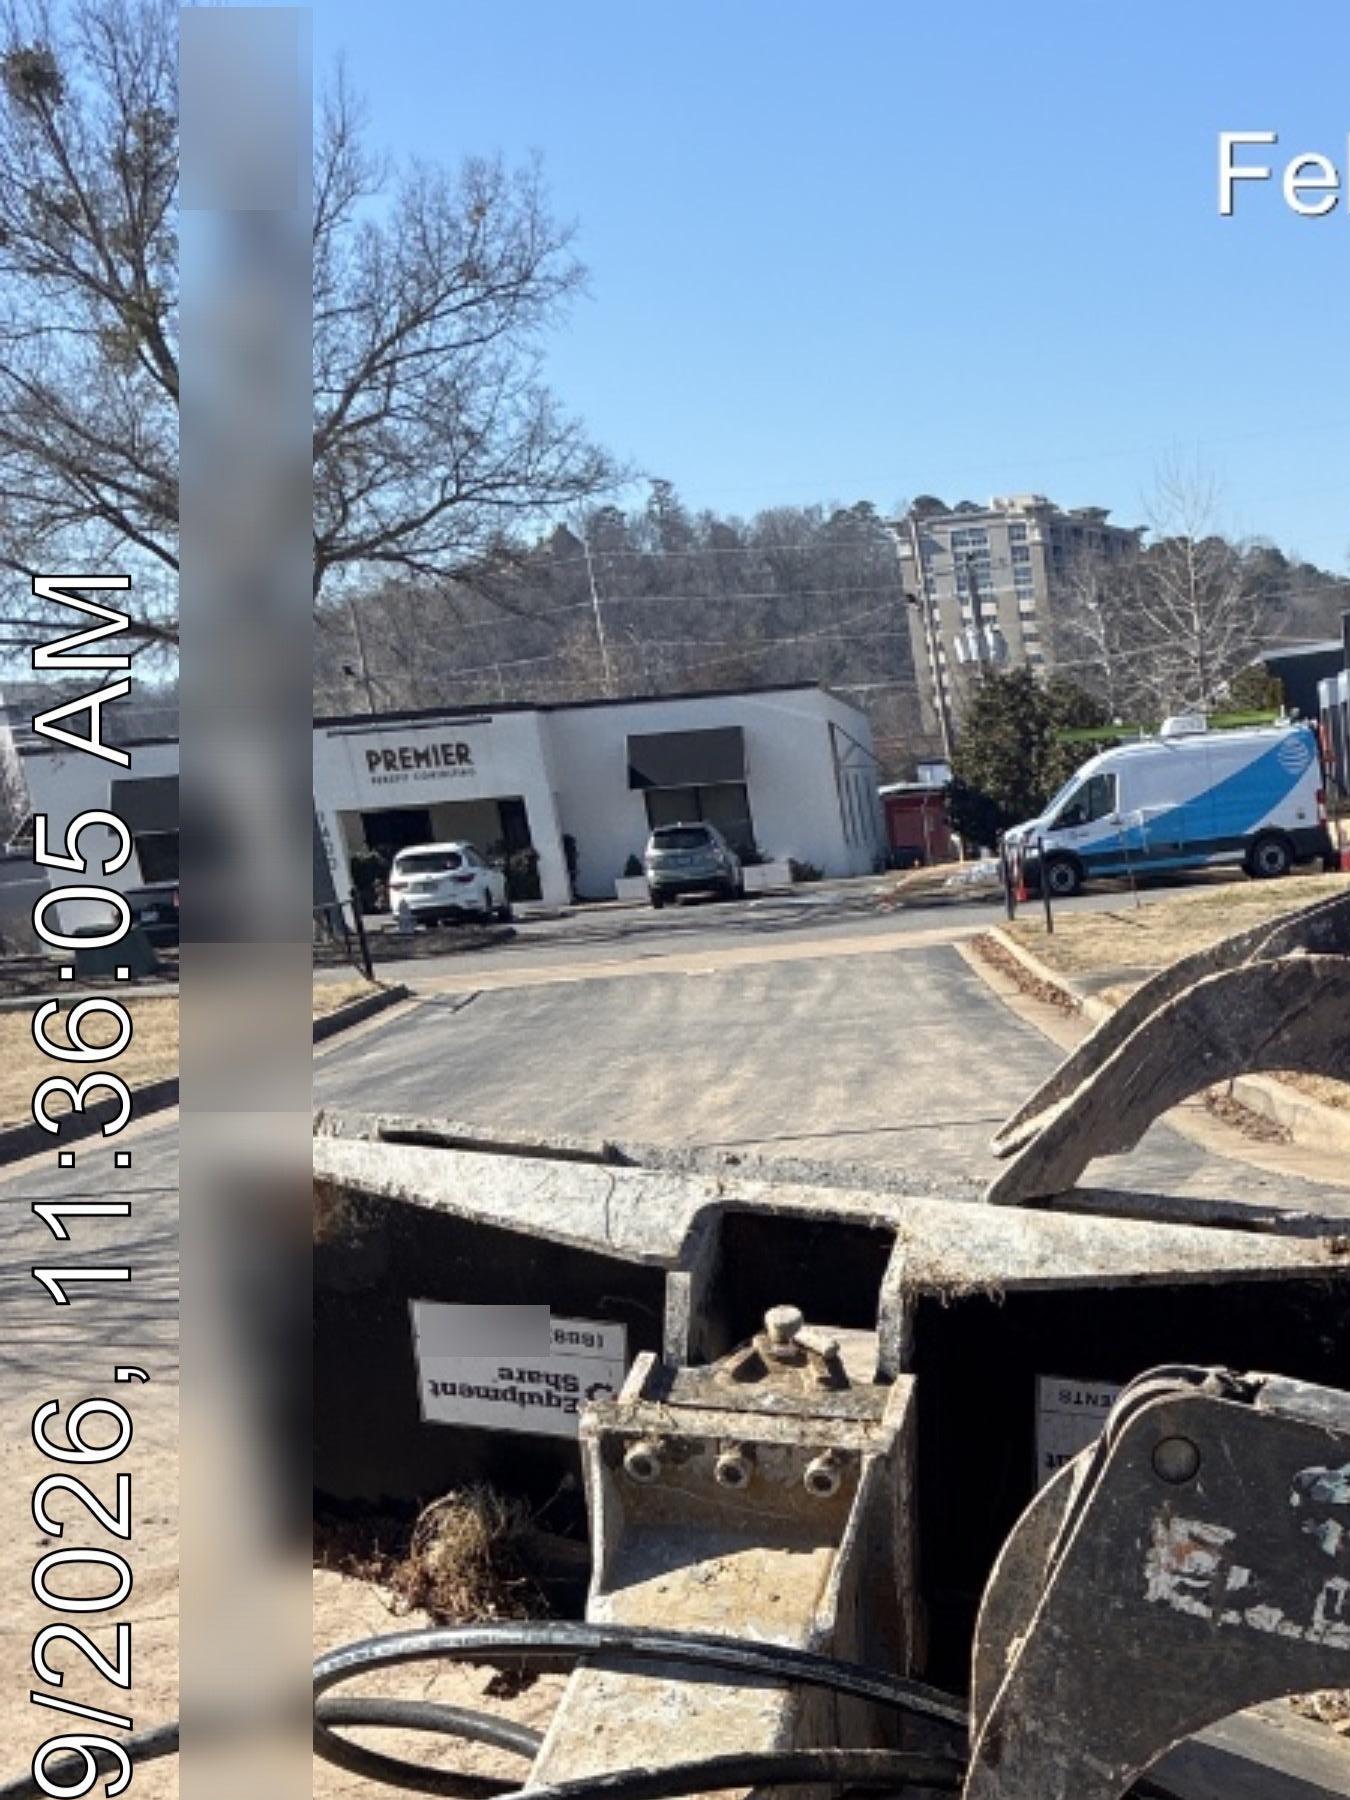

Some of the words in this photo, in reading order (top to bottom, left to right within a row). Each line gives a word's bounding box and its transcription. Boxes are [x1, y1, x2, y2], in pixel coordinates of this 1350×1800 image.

[366, 742, 475, 773] PREMIER
[497, 1366, 580, 1393] Share
[428, 1379, 579, 1415] Equipment
